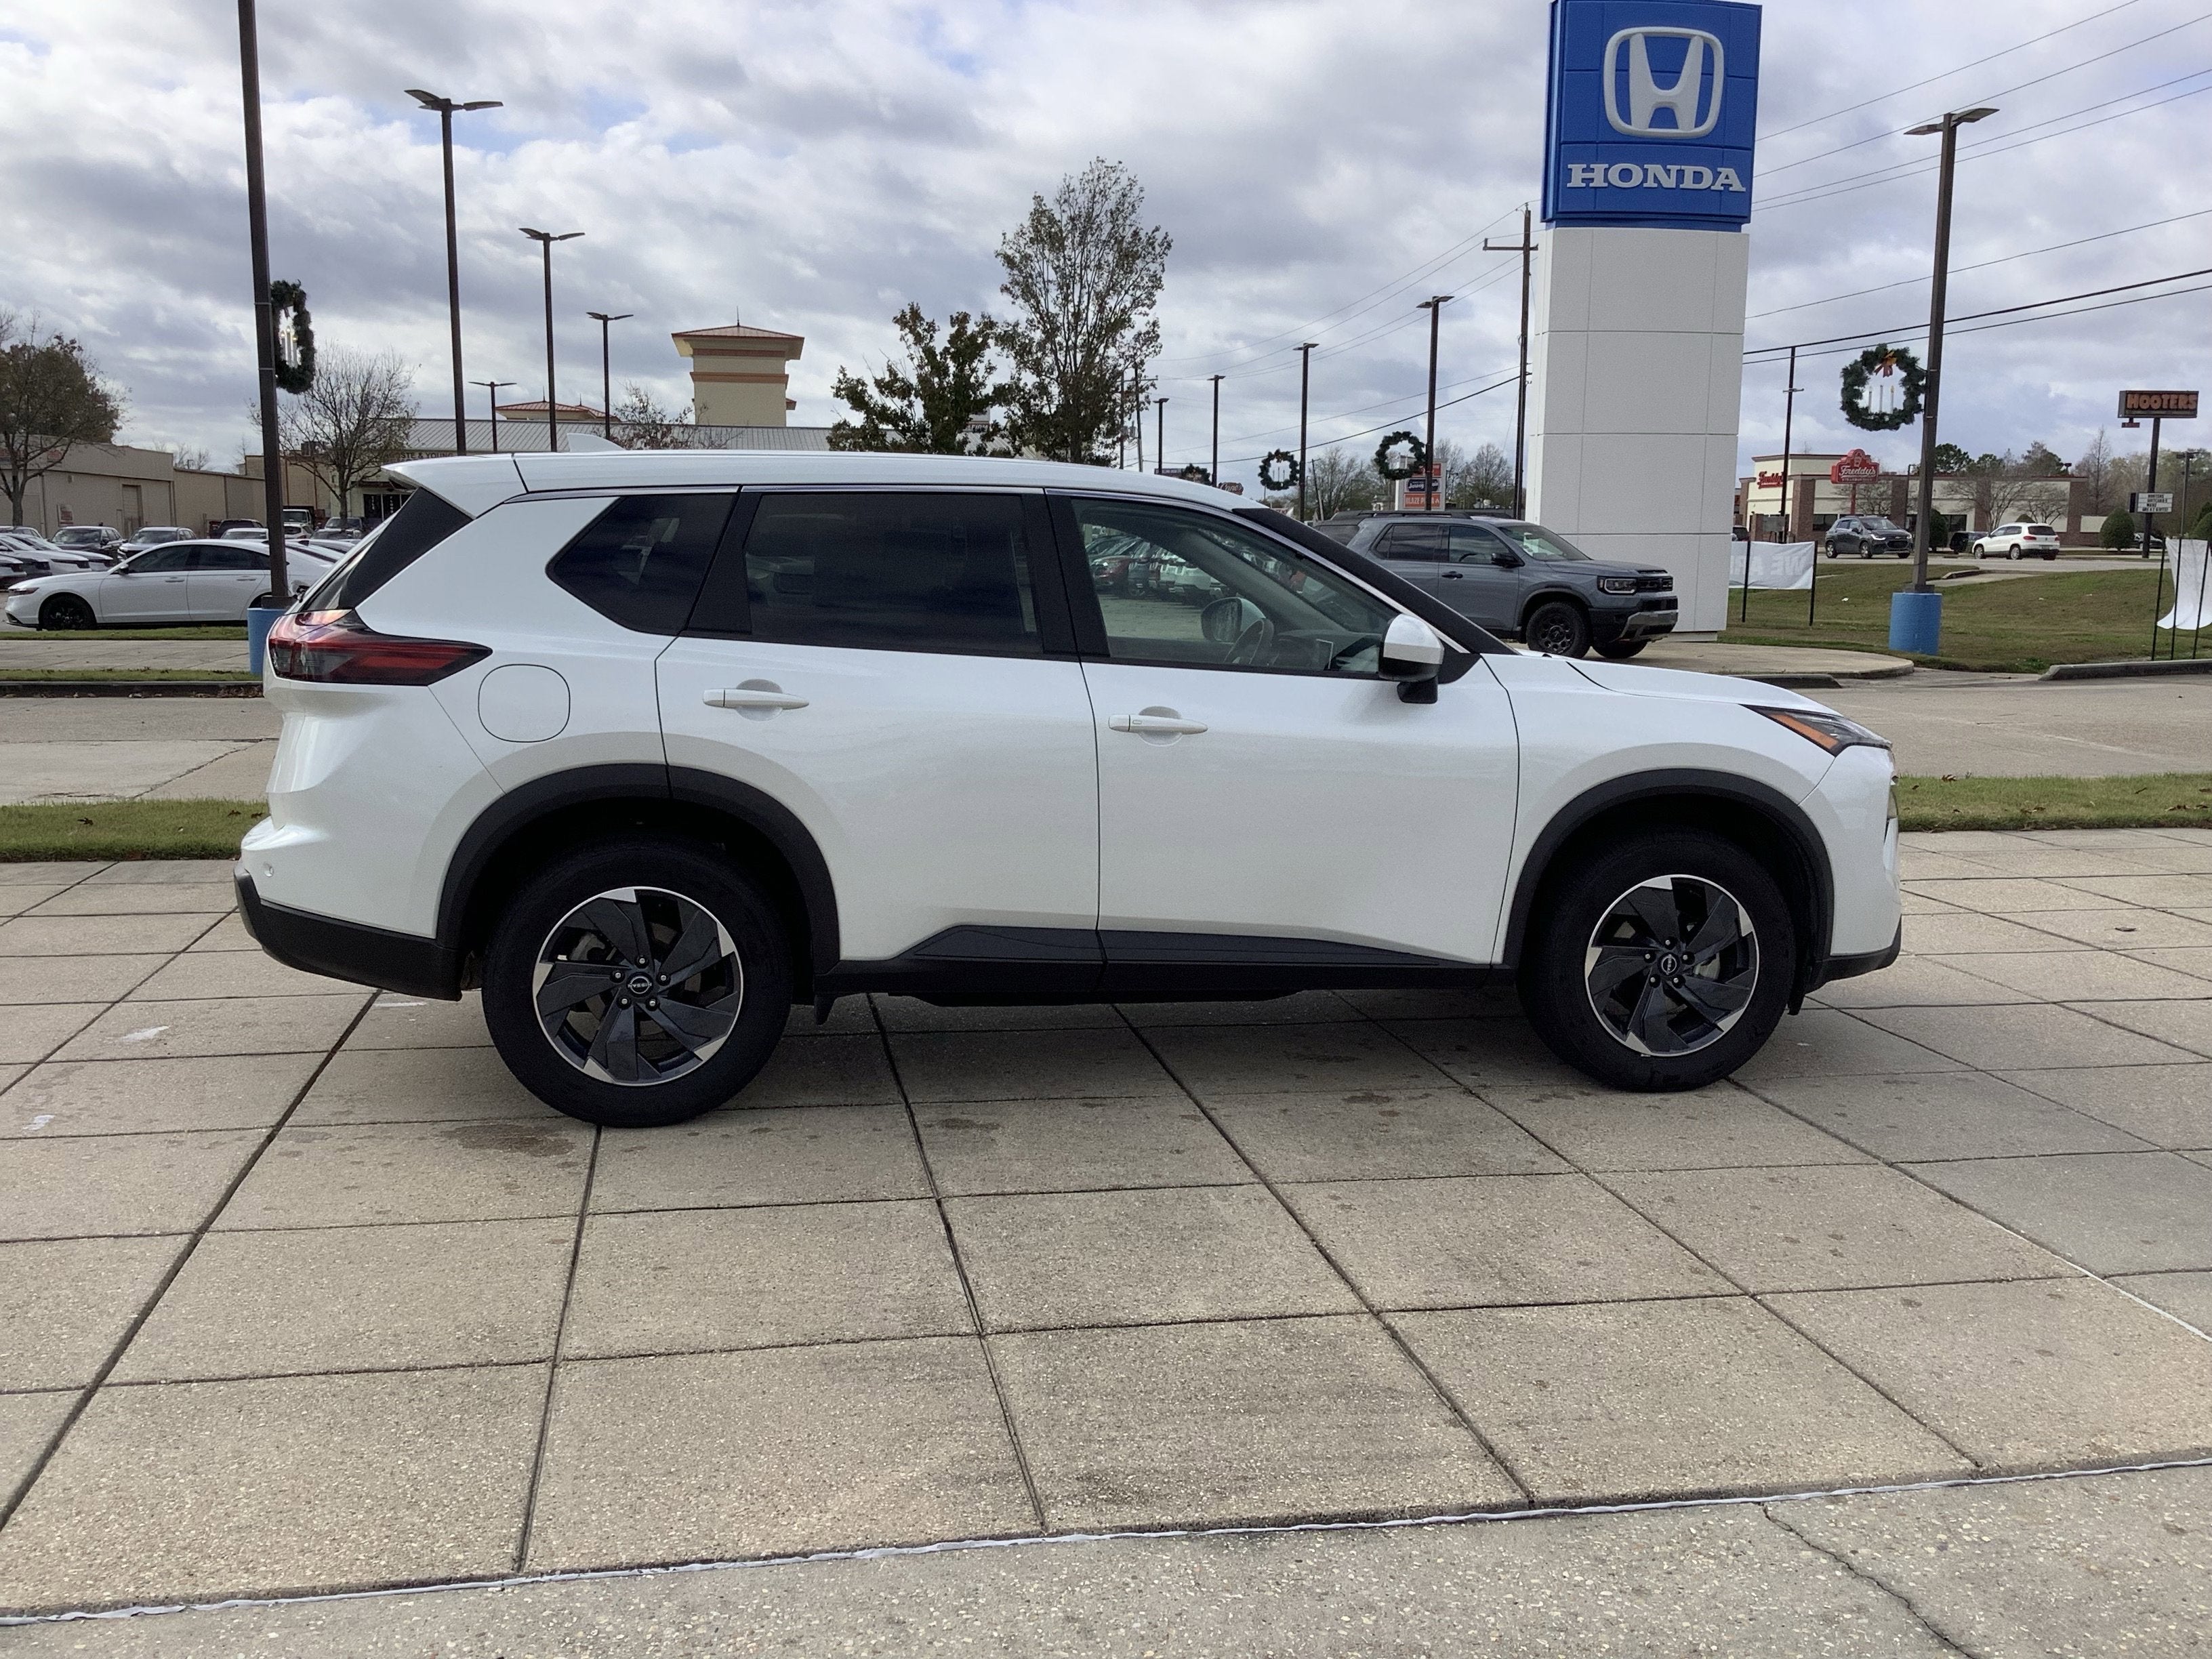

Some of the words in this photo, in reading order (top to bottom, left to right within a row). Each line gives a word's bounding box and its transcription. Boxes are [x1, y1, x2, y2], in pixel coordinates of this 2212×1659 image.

[1566, 163, 1746, 192] HONDA
[2127, 394, 2197, 409] HOOTERS
[1839, 466, 1877, 476] Freddy's
